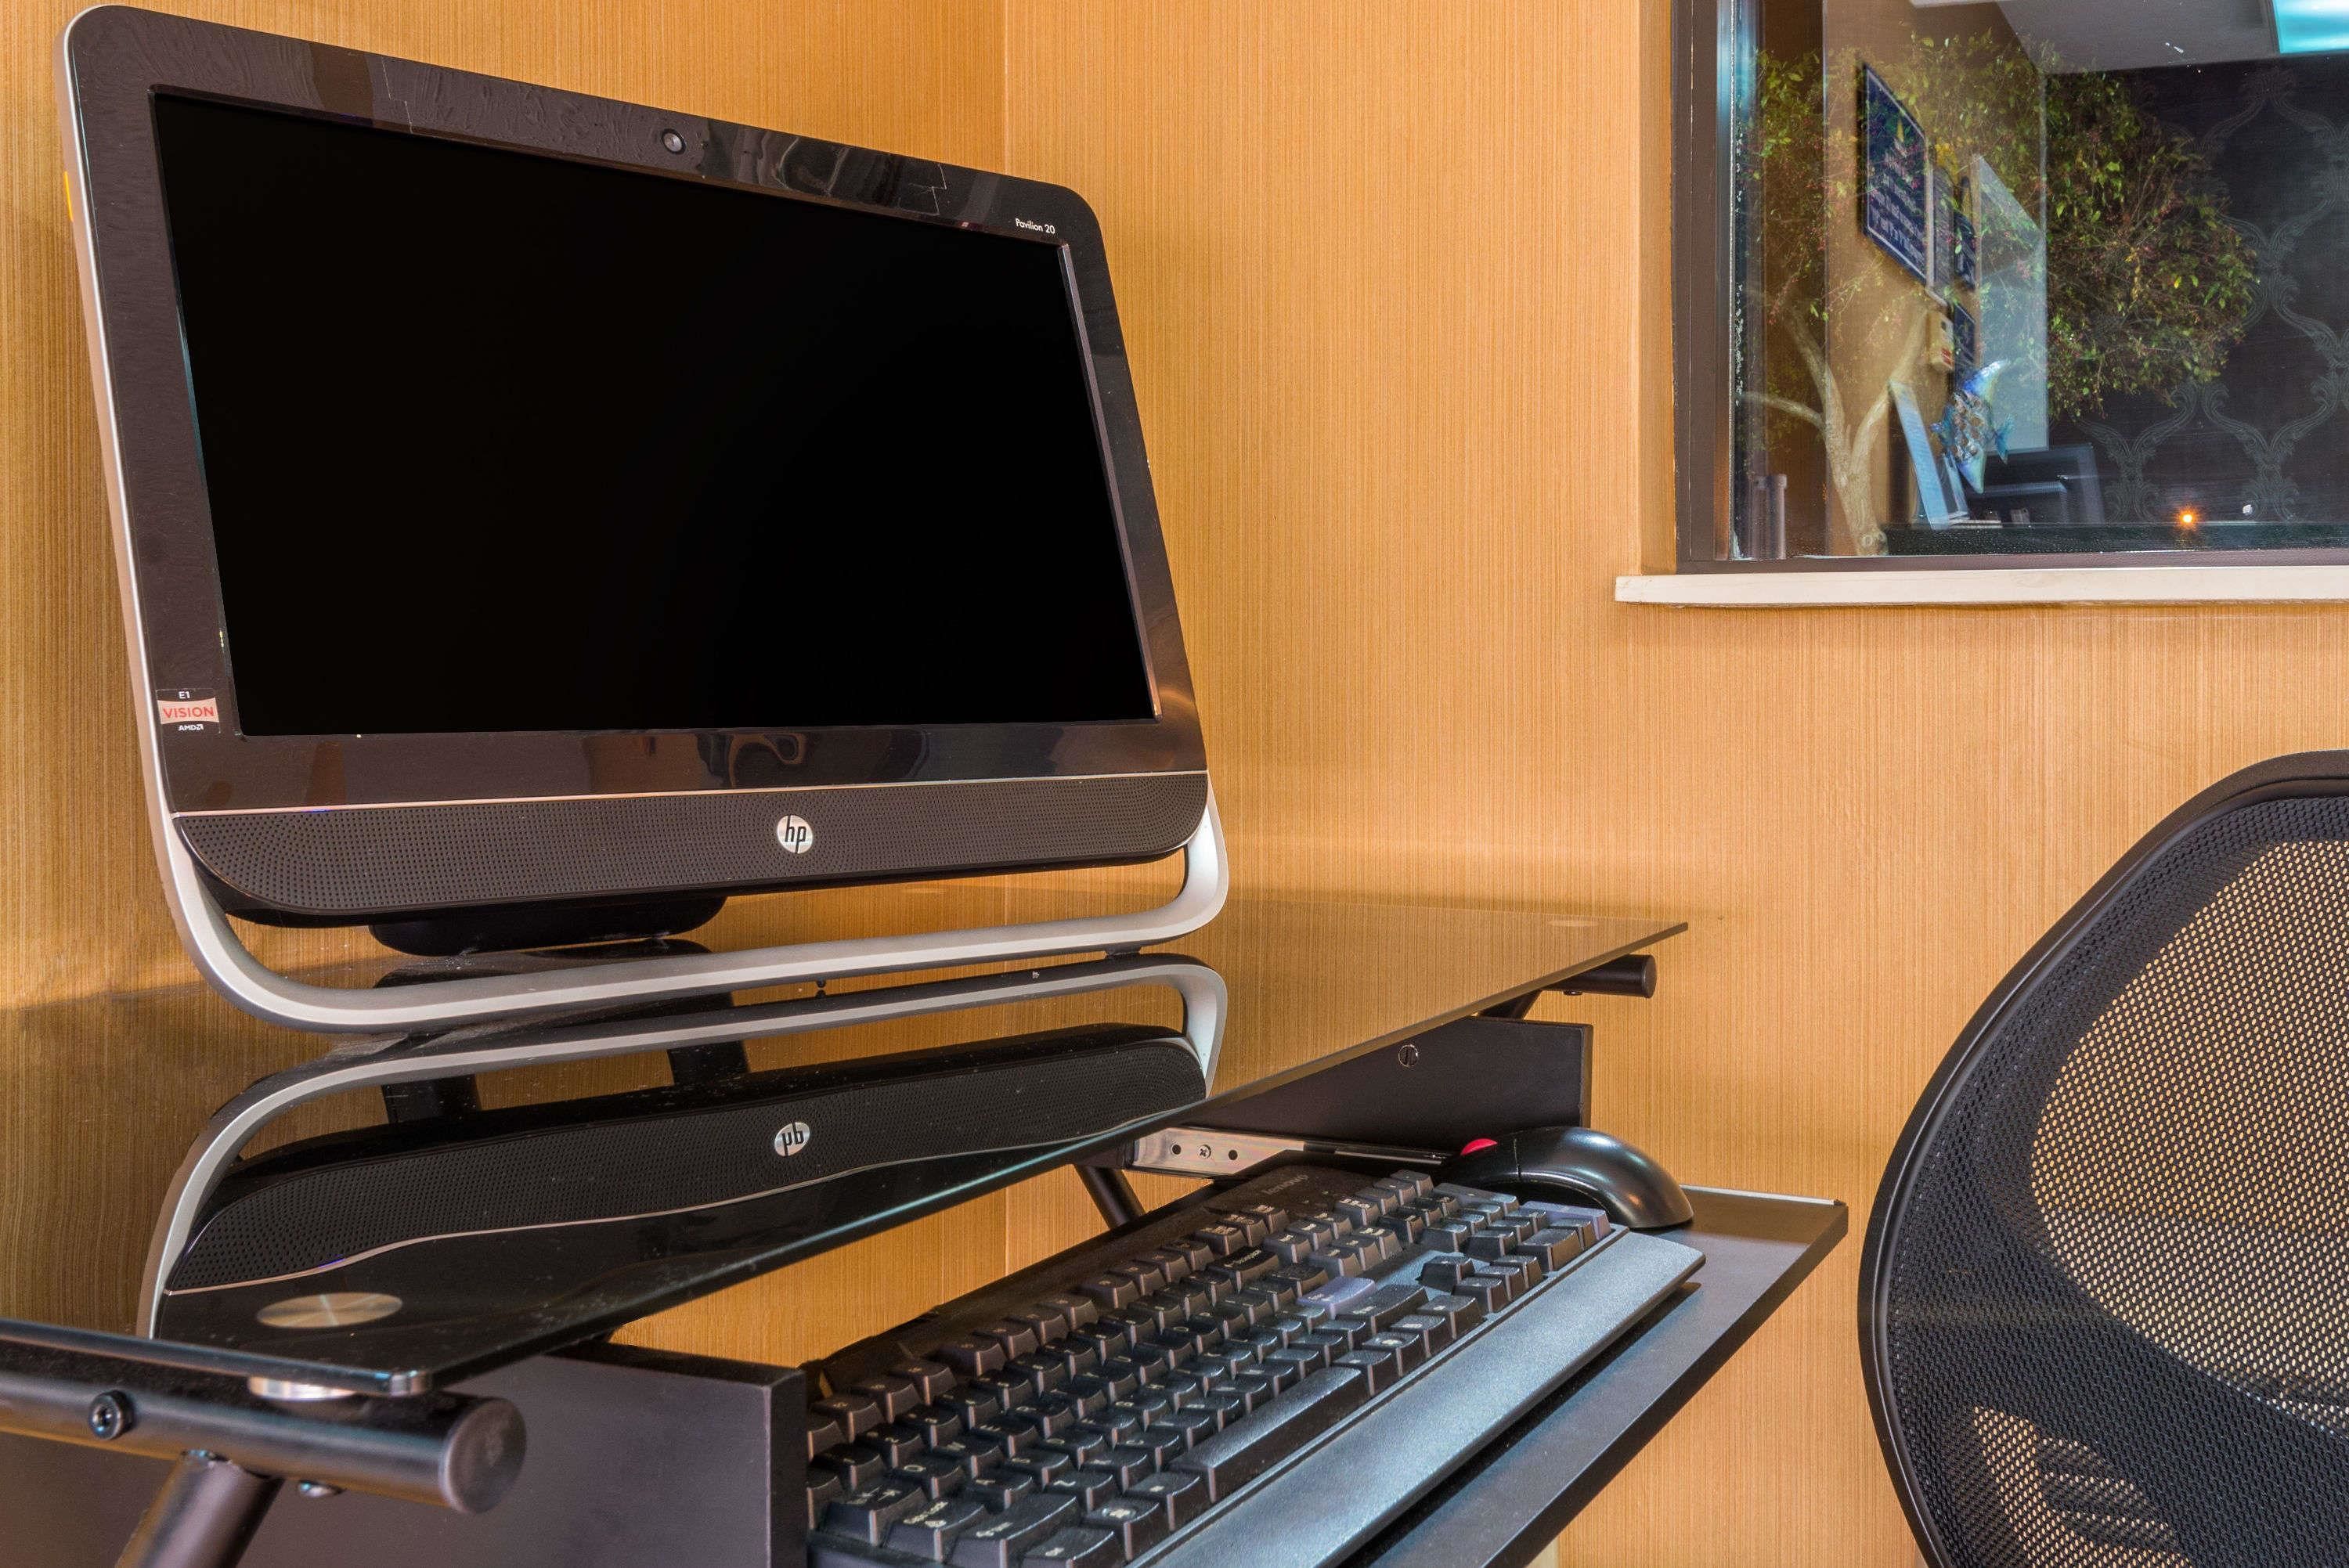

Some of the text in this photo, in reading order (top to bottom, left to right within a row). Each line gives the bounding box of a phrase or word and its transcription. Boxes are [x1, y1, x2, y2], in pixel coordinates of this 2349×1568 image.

[1015, 218, 1055, 234] Pavilion 20
[179, 690, 190, 699] E1
[163, 706, 215, 719] VISION
[782, 814, 809, 854] hp
